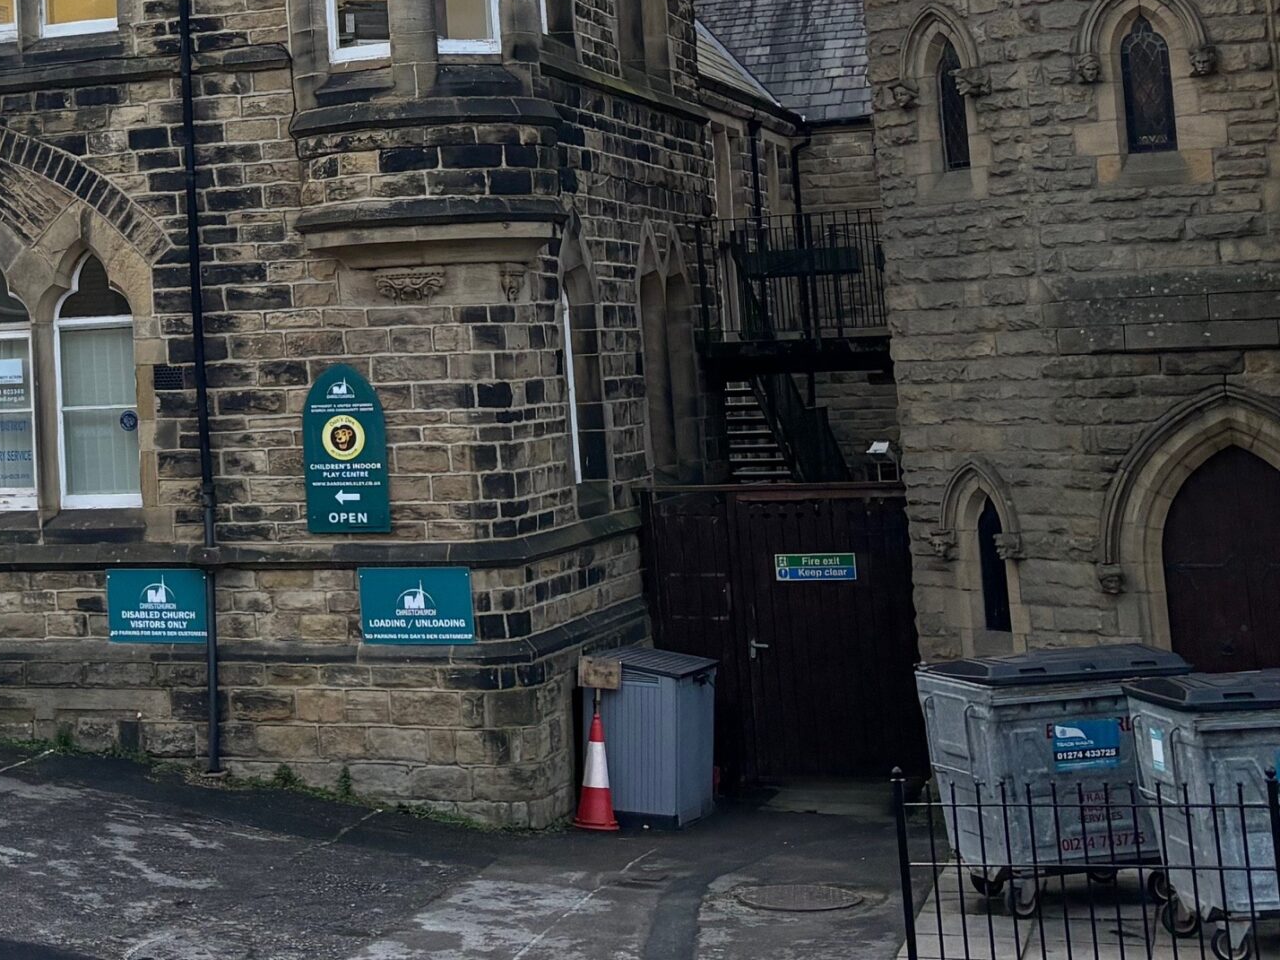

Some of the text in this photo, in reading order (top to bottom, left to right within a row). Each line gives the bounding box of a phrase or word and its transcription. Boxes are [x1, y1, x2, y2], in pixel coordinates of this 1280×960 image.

[7, 450, 32, 461] SERVICE
[328, 512, 368, 523] OPEN
[802, 557, 839, 565] Fire exit
[798, 569, 822, 577] Keep
[122, 611, 196, 619] DISABLED CHURCH
[130, 620, 187, 629] VISITORS ONLY
[369, 619, 465, 628] LOADING / UNLOADING
[1057, 748, 1116, 760] 01274 433725
[1062, 836, 1095, 851] 0124
